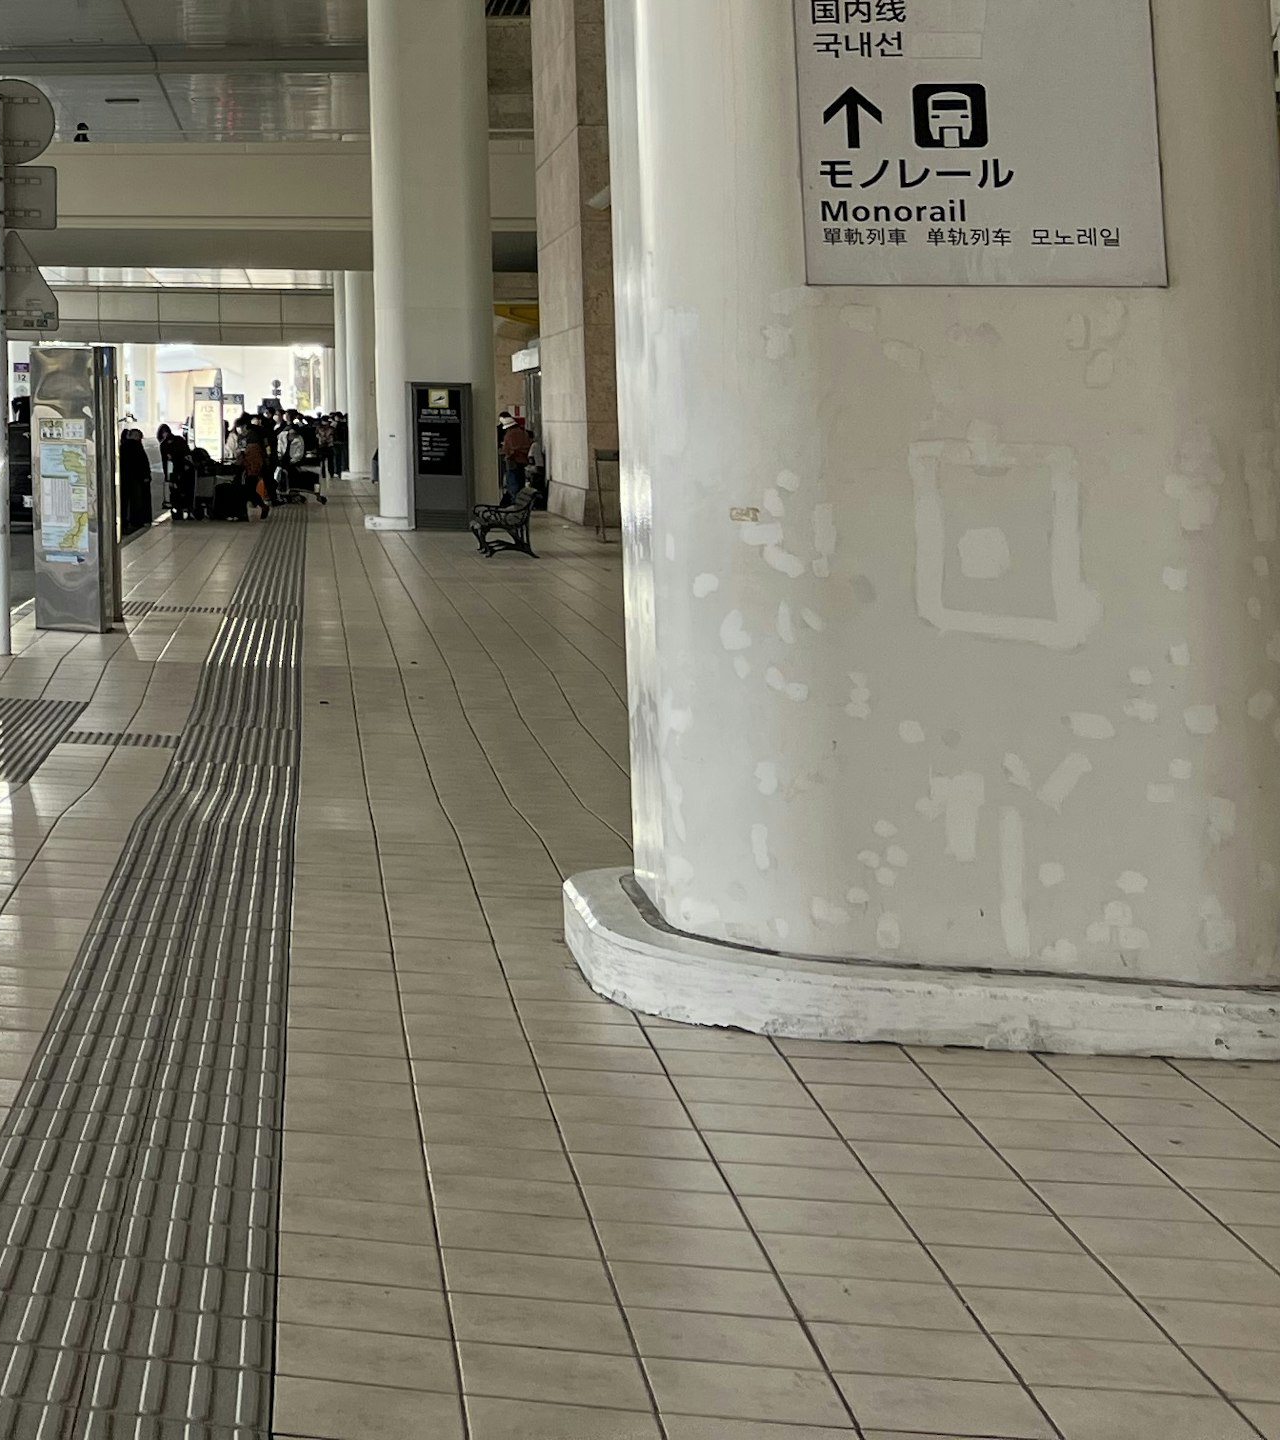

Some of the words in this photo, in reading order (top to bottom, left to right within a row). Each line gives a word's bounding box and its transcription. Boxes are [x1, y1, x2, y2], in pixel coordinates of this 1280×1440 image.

[812, 32, 904, 59] 국내선
[819, 158, 1015, 189] モノレール
[820, 198, 966, 222] Monorail
[822, 227, 908, 246] 單軌列車
[926, 227, 1012, 247] 单轨列车
[1031, 227, 1121, 247] 모노레일
